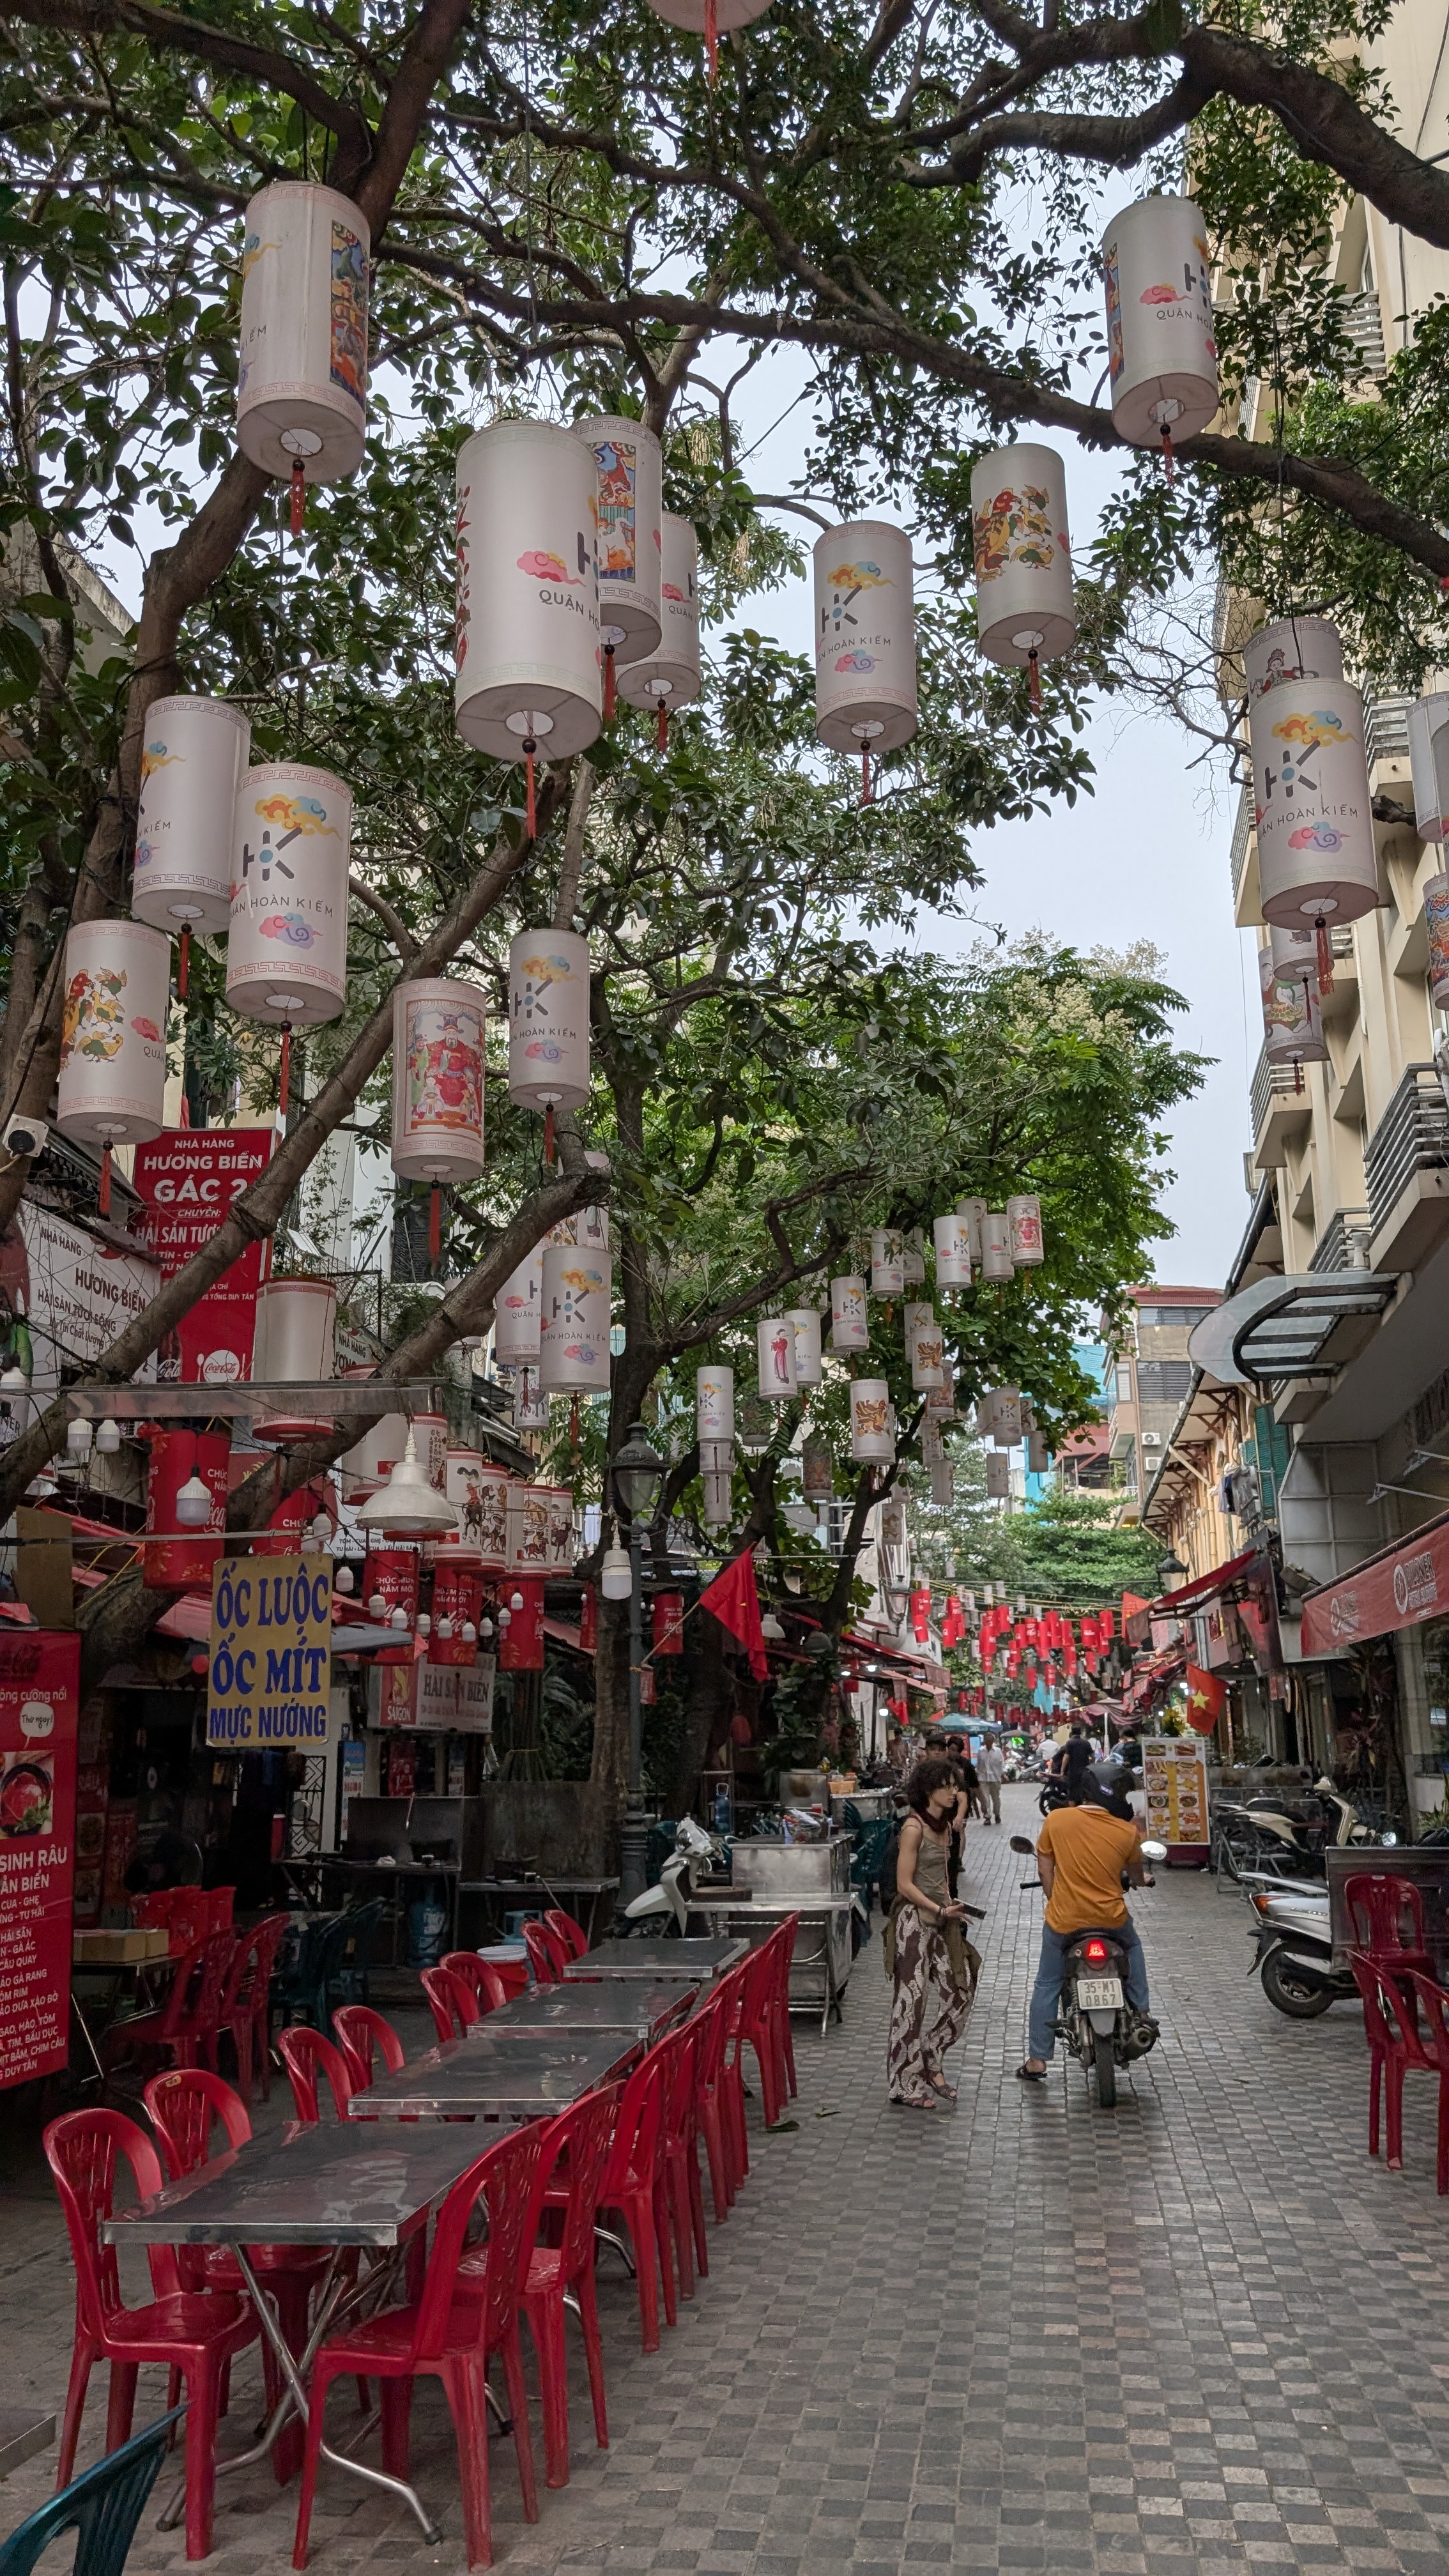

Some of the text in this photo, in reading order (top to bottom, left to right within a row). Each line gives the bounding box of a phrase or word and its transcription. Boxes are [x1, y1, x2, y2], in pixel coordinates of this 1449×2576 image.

[1156, 308, 1193, 320] QUẬN
[539, 590, 584, 615] QUẬN
[828, 634, 891, 654] HOÀN KIẾM
[1278, 808, 1315, 827] HOÀN
[1322, 803, 1358, 818] KIẾM
[251, 894, 289, 908] HOÀN
[296, 898, 334, 917] KIẾM
[519, 1027, 576, 1039] HOÀN KIẾM
[174, 1138, 235, 1149] NHÀ HÀNG
[144, 1149, 263, 1170] HƯƠNG BIỂN
[154, 1174, 249, 1202] GÁC 2
[41, 1226, 82, 1257] NHÀ HÀNG
[161, 1218, 188, 1243] SẢN
[75, 1267, 146, 1314] HƯƠNG BIỂN
[512, 1311, 533, 1319] QUẬN
[558, 1331, 583, 1340] HOÀN
[216, 1561, 252, 1629] ỐC
[258, 1563, 329, 1636] LUỘC
[379, 1584, 399, 1593] NĂM
[213, 1632, 327, 1696] ỐC MÍT
[210, 1697, 326, 1745] MỰC NƯỚNG
[38, 1843, 67, 1867] RÂU
[1, 1898, 17, 1910] CUA
[16, 1954, 38, 1967] QUAY
[1086, 1994, 1116, 2007] 0867
